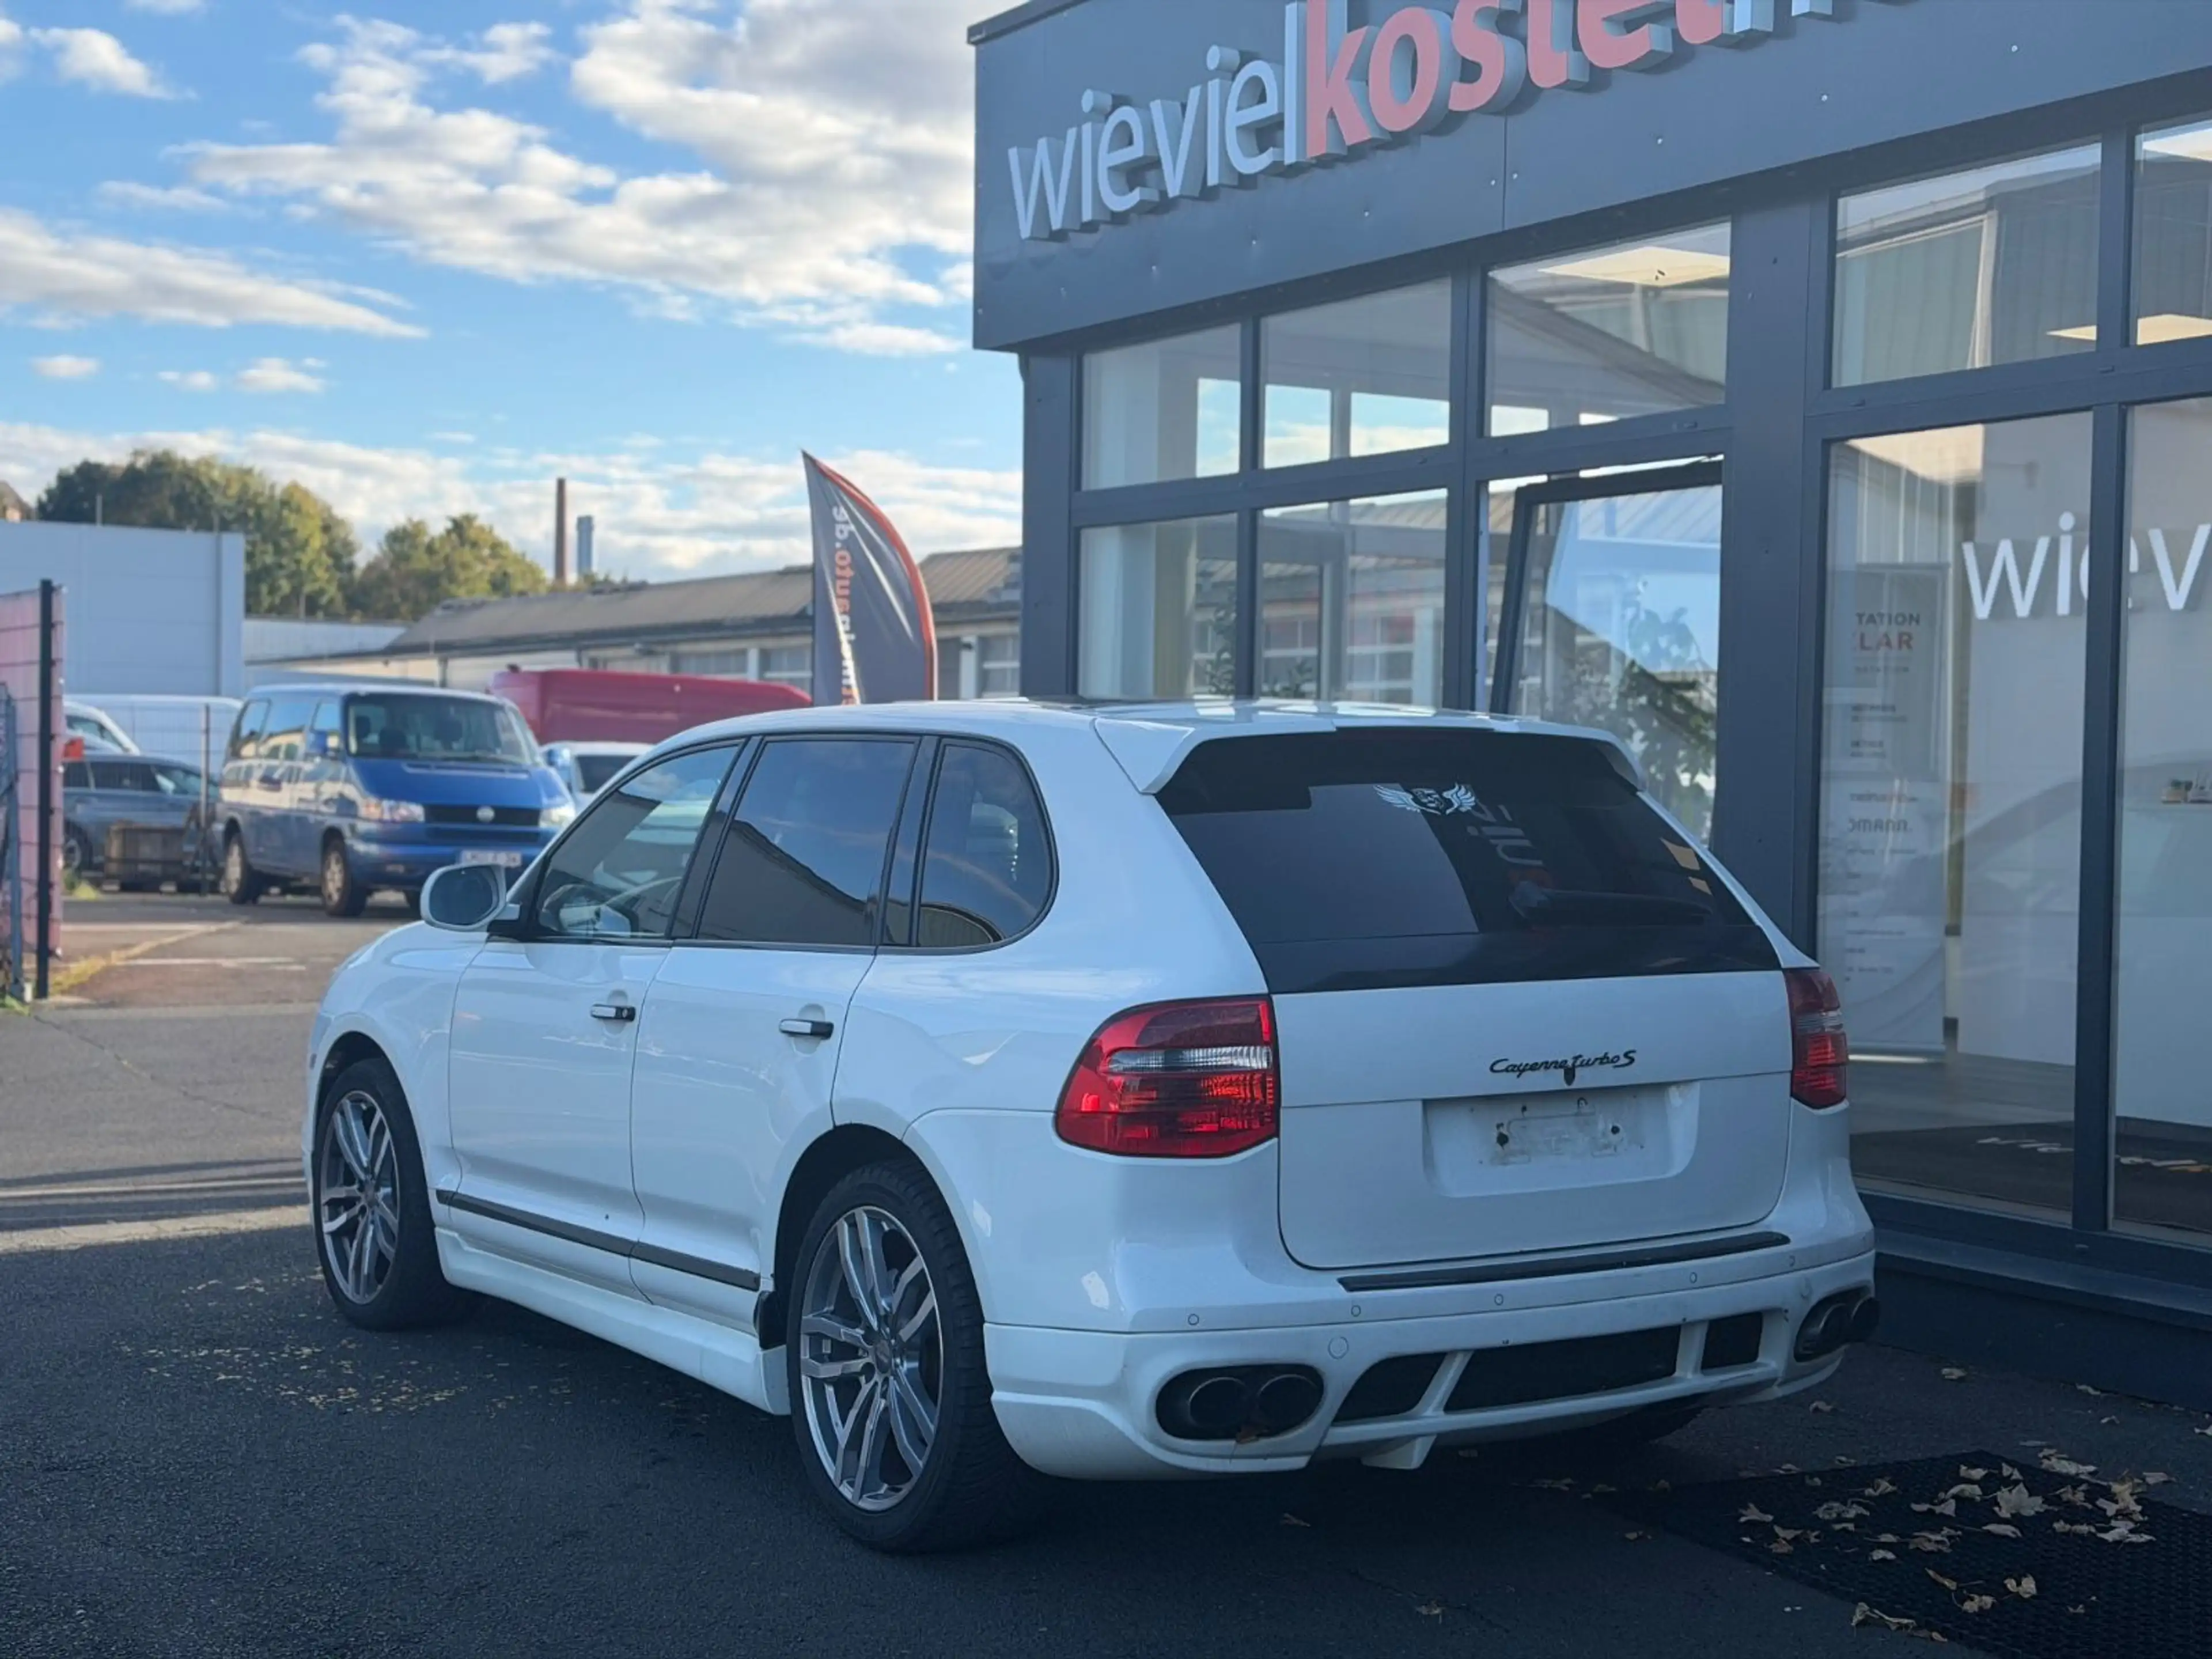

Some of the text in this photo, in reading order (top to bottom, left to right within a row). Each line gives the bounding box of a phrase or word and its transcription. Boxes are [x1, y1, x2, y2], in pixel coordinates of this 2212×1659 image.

[1851, 631, 1913, 651] LAR
[1488, 1058, 1568, 1078] Cayenne
[1613, 1050, 1637, 1068] S
